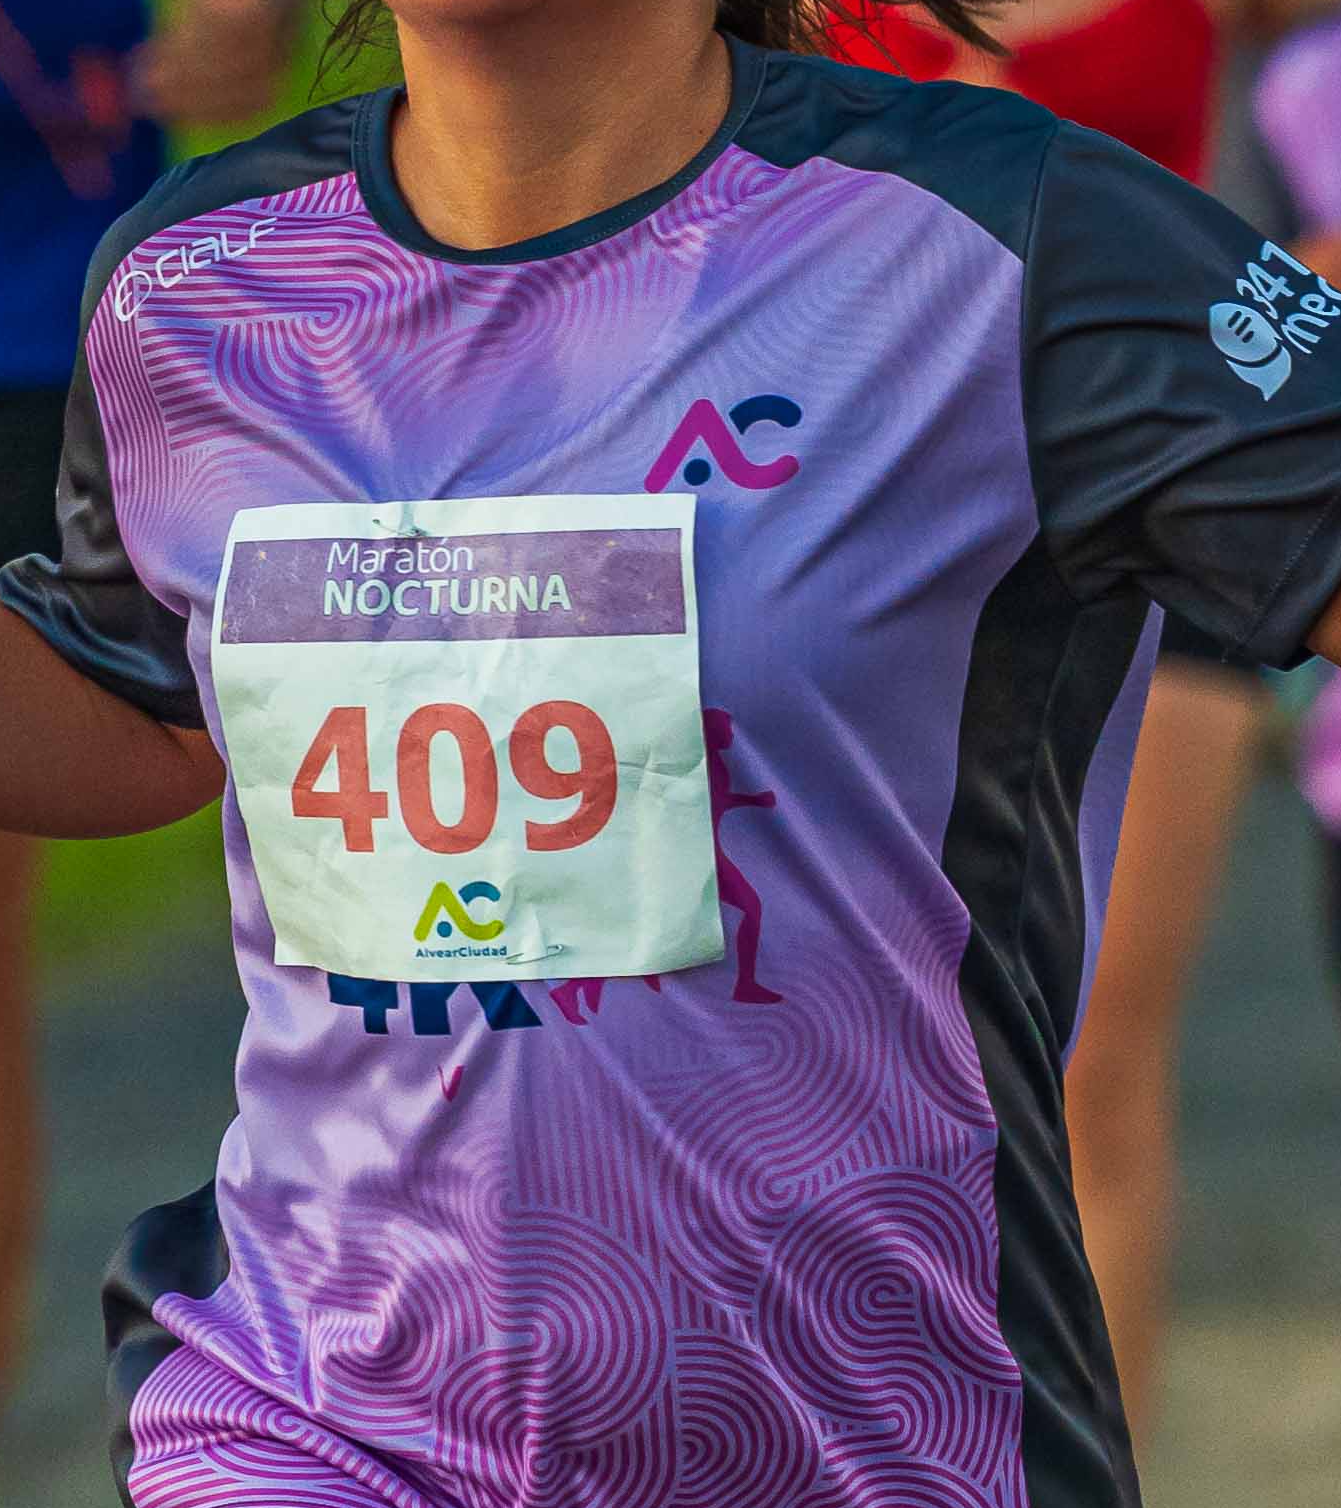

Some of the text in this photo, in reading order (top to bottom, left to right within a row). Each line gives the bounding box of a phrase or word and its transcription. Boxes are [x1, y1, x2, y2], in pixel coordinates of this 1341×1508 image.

[326, 538, 474, 574] Maratón
[323, 574, 573, 616] NOCTURNA
[291, 700, 618, 854] 409
[415, 945, 508, 958] AlvearCiudad
